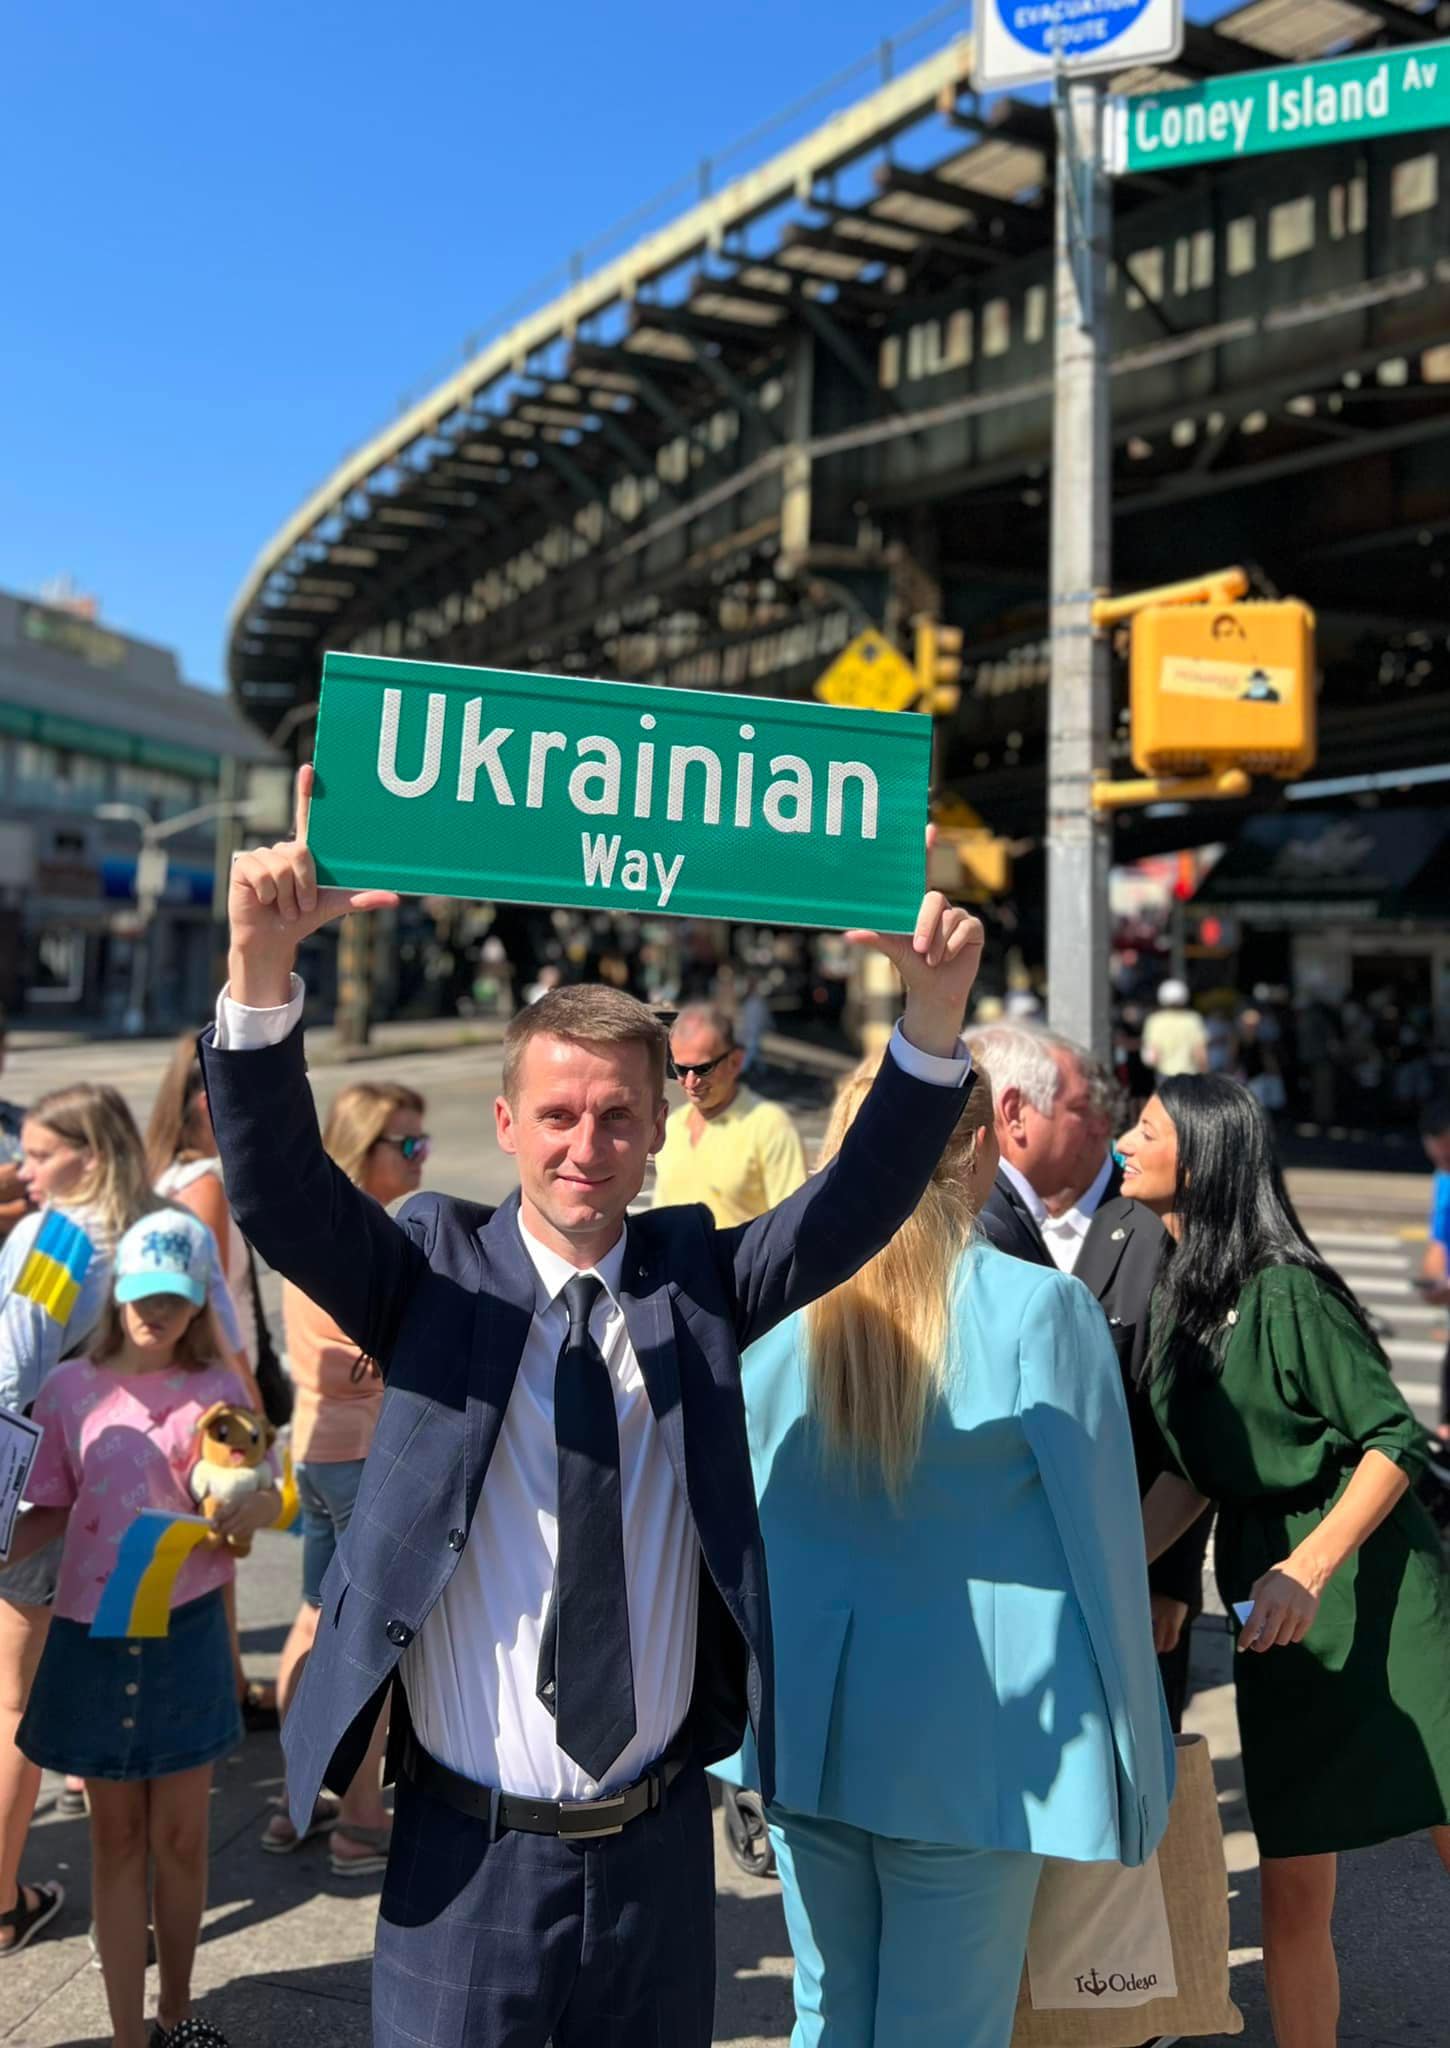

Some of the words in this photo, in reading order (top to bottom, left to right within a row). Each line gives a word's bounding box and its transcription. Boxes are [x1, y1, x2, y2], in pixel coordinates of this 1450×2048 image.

[1043, 18, 1109, 47] ROUTE
[1135, 98, 1254, 154] Coney
[1267, 63, 1389, 133] Island
[1402, 56, 1438, 92] Av
[377, 687, 879, 840] Ukrainian
[581, 831, 685, 907] Way
[1075, 1975, 1085, 1993] I
[1109, 1974, 1157, 1992] Odesa
